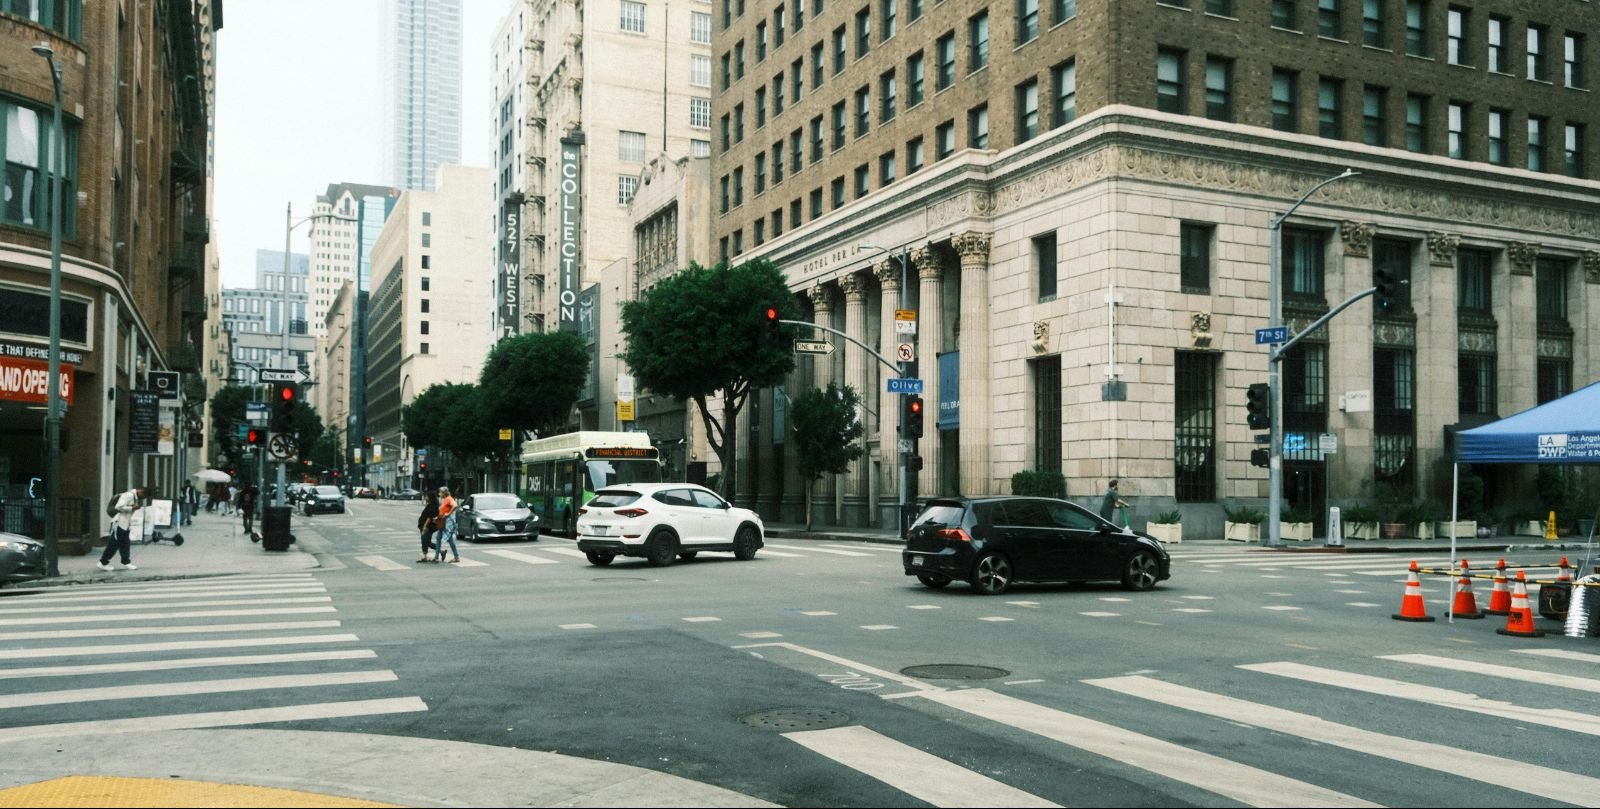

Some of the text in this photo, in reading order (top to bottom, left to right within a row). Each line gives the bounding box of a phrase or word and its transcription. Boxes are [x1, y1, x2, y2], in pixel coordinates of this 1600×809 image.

[563, 151, 576, 160] the
[507, 214, 517, 253] 527
[561, 163, 577, 321] COLLECTION
[803, 256, 828, 273] HOTEL
[832, 250, 847, 263] PER
[505, 263, 519, 316] WEST
[1258, 331, 1284, 342] 7th St
[6, 344, 24, 356] THAT
[797, 343, 826, 351] ONE WAY
[22, 368, 69, 397] OPEG
[892, 381, 919, 390] Olive
[1540, 436, 1554, 446] LA
[1580, 434, 1600, 442] Angel
[624, 449, 647, 457] DISTRICT
[1539, 447, 1566, 457] DWP
[1588, 449, 1593, 457] &
